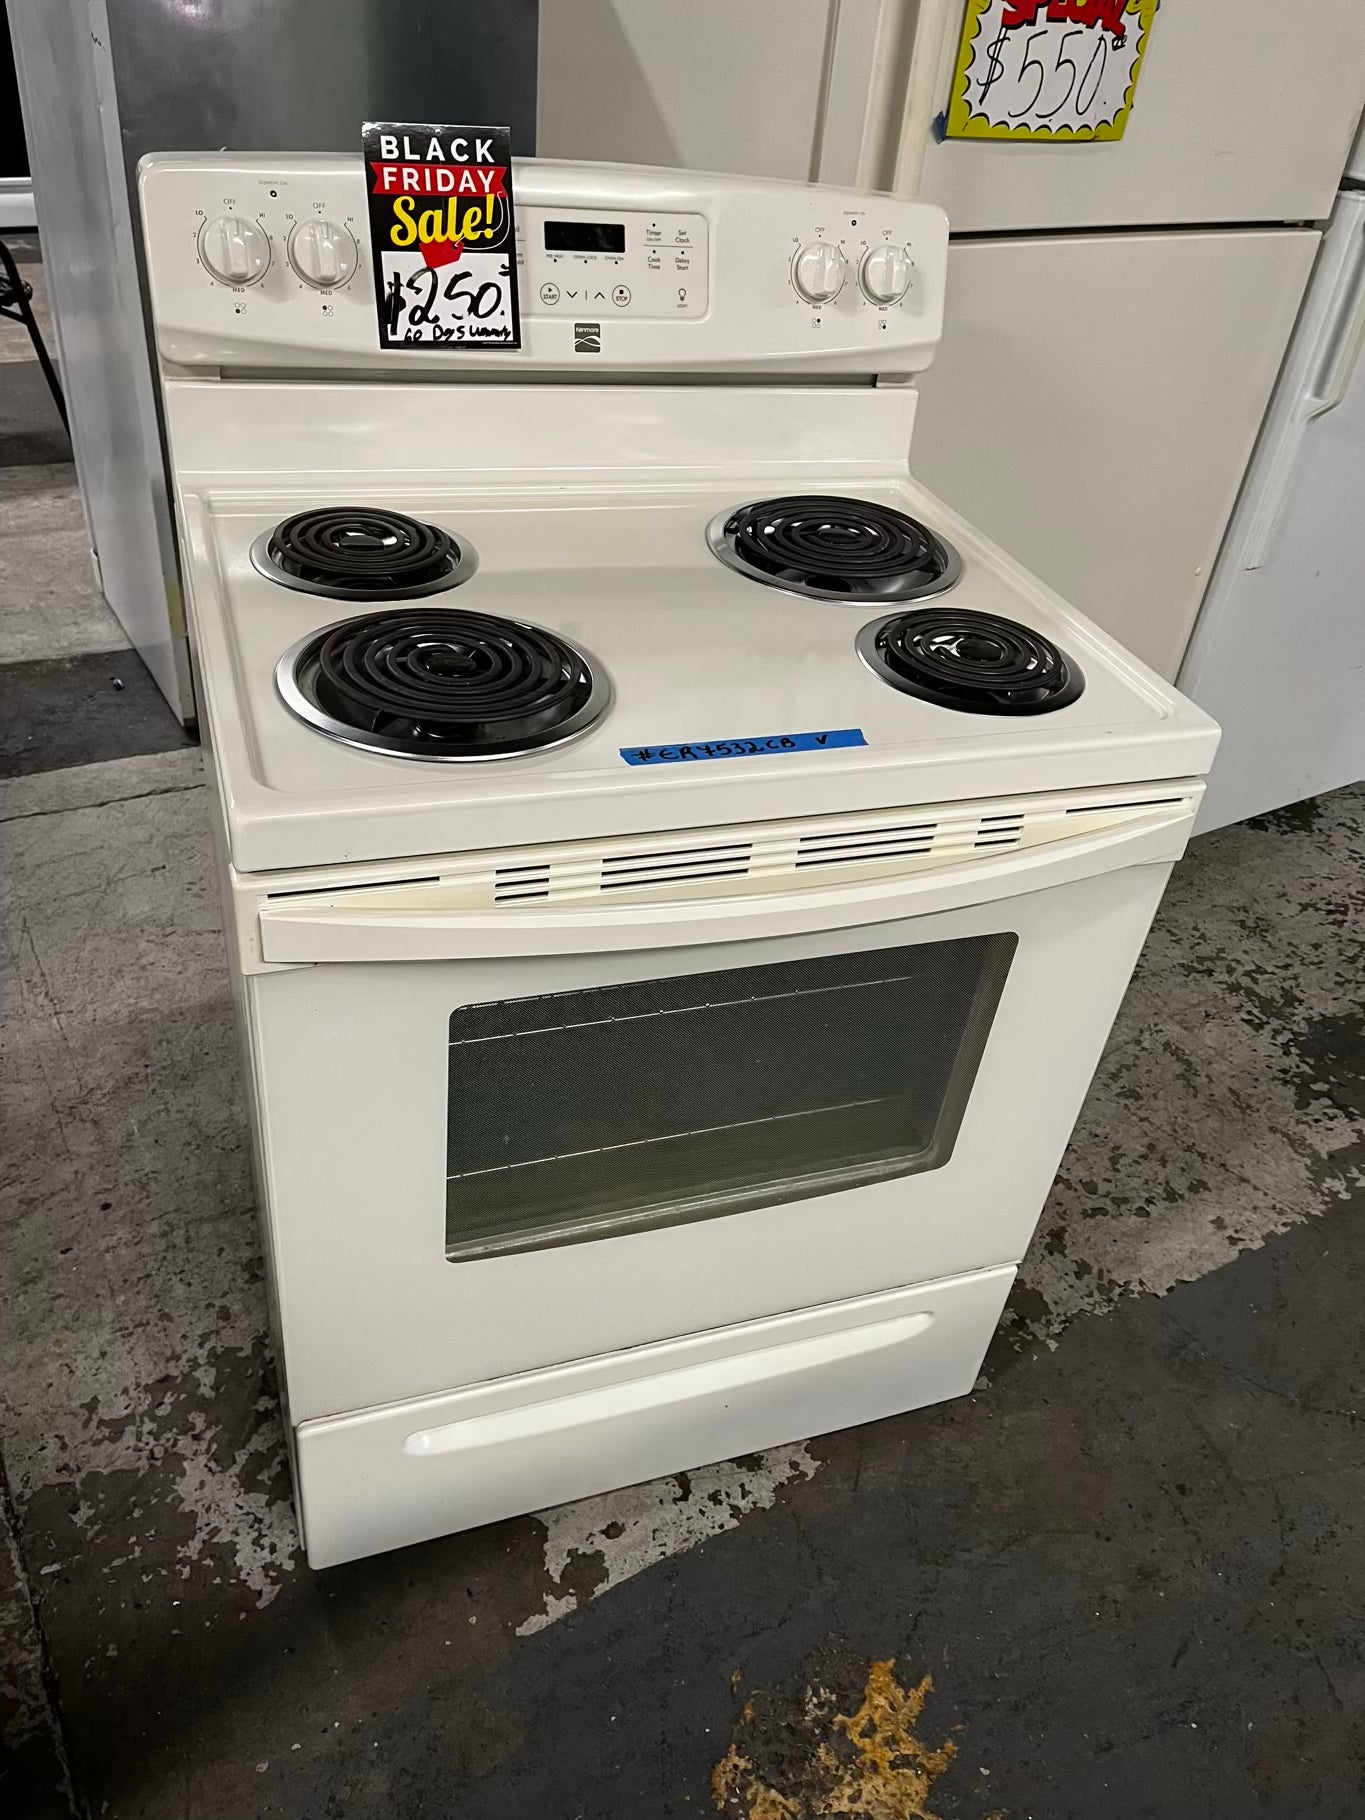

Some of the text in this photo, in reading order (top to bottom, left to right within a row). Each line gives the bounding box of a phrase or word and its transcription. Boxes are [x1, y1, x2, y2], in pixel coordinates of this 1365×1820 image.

[380, 135, 495, 163] BLACK
[382, 166, 495, 193] FRIDAY
[390, 193, 495, 246] Sale!
